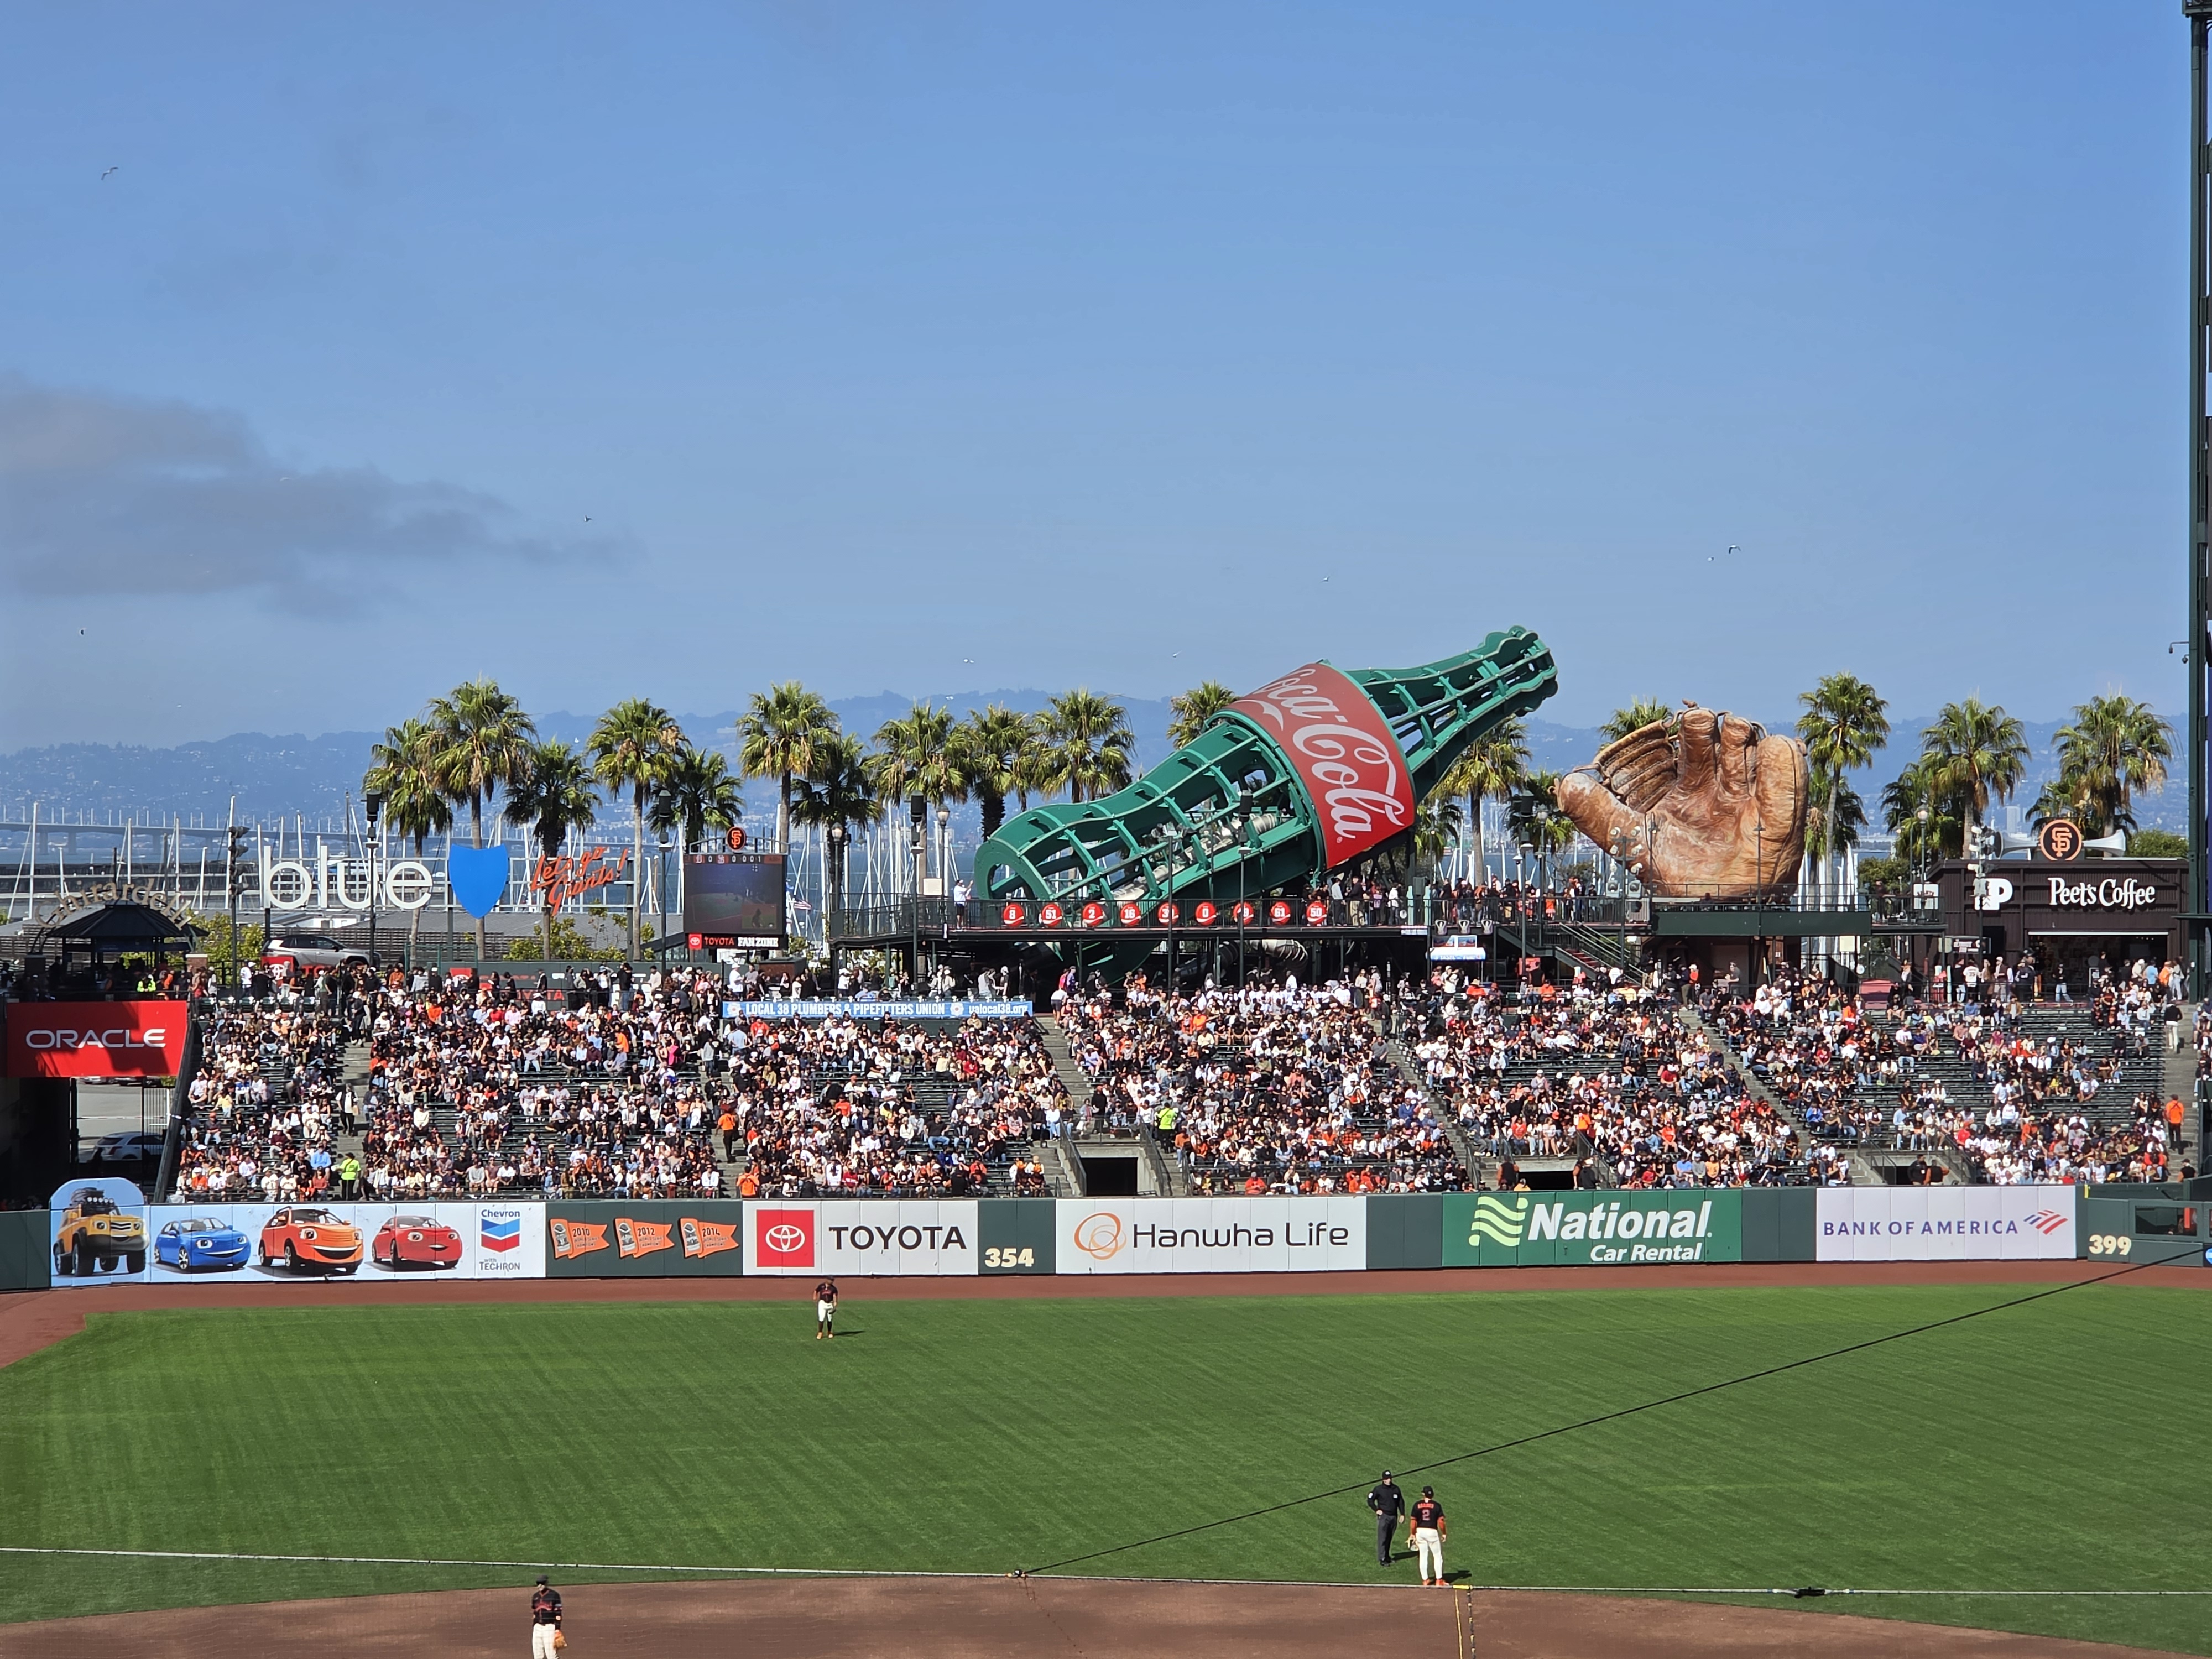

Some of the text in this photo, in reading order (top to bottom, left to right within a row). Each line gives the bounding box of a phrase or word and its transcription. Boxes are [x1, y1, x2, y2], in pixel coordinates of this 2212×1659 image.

[576, 846, 608, 878] go
[264, 845, 433, 910] blue
[2047, 877, 2156, 909] Peet's Coffee
[34, 878, 192, 930] Ghirardelli
[1009, 910, 1016, 919] 8
[1045, 909, 1057, 919] 51
[1088, 909, 1095, 919] 2
[1202, 908, 1209, 918] 0
[1310, 907, 1322, 917] 50
[704, 936, 779, 947] TOYOTA FAN ZONE
[745, 1004, 1029, 1016] LOCAL 38 PLUMBERS & PIPEFITTERS UNION ualocal38.org
[26, 1029, 166, 1048] ORACLE
[481, 1209, 520, 1218] Chevron
[572, 1228, 590, 1237] 2010
[637, 1227, 655, 1237] 2012
[702, 1227, 720, 1237] 2014
[1824, 1220, 2018, 1236] BANK OF AMERICA
[829, 1226, 967, 1250] TOYOTA
[1133, 1222, 1348, 1249] Hanwha Life
[2089, 1234, 2131, 1256] 399
[1590, 1242, 1702, 1261] Car Rental
[984, 1248, 1034, 1268] 354
[479, 1261, 520, 1272] TECHRON
[1422, 1509, 1430, 1521] 2
